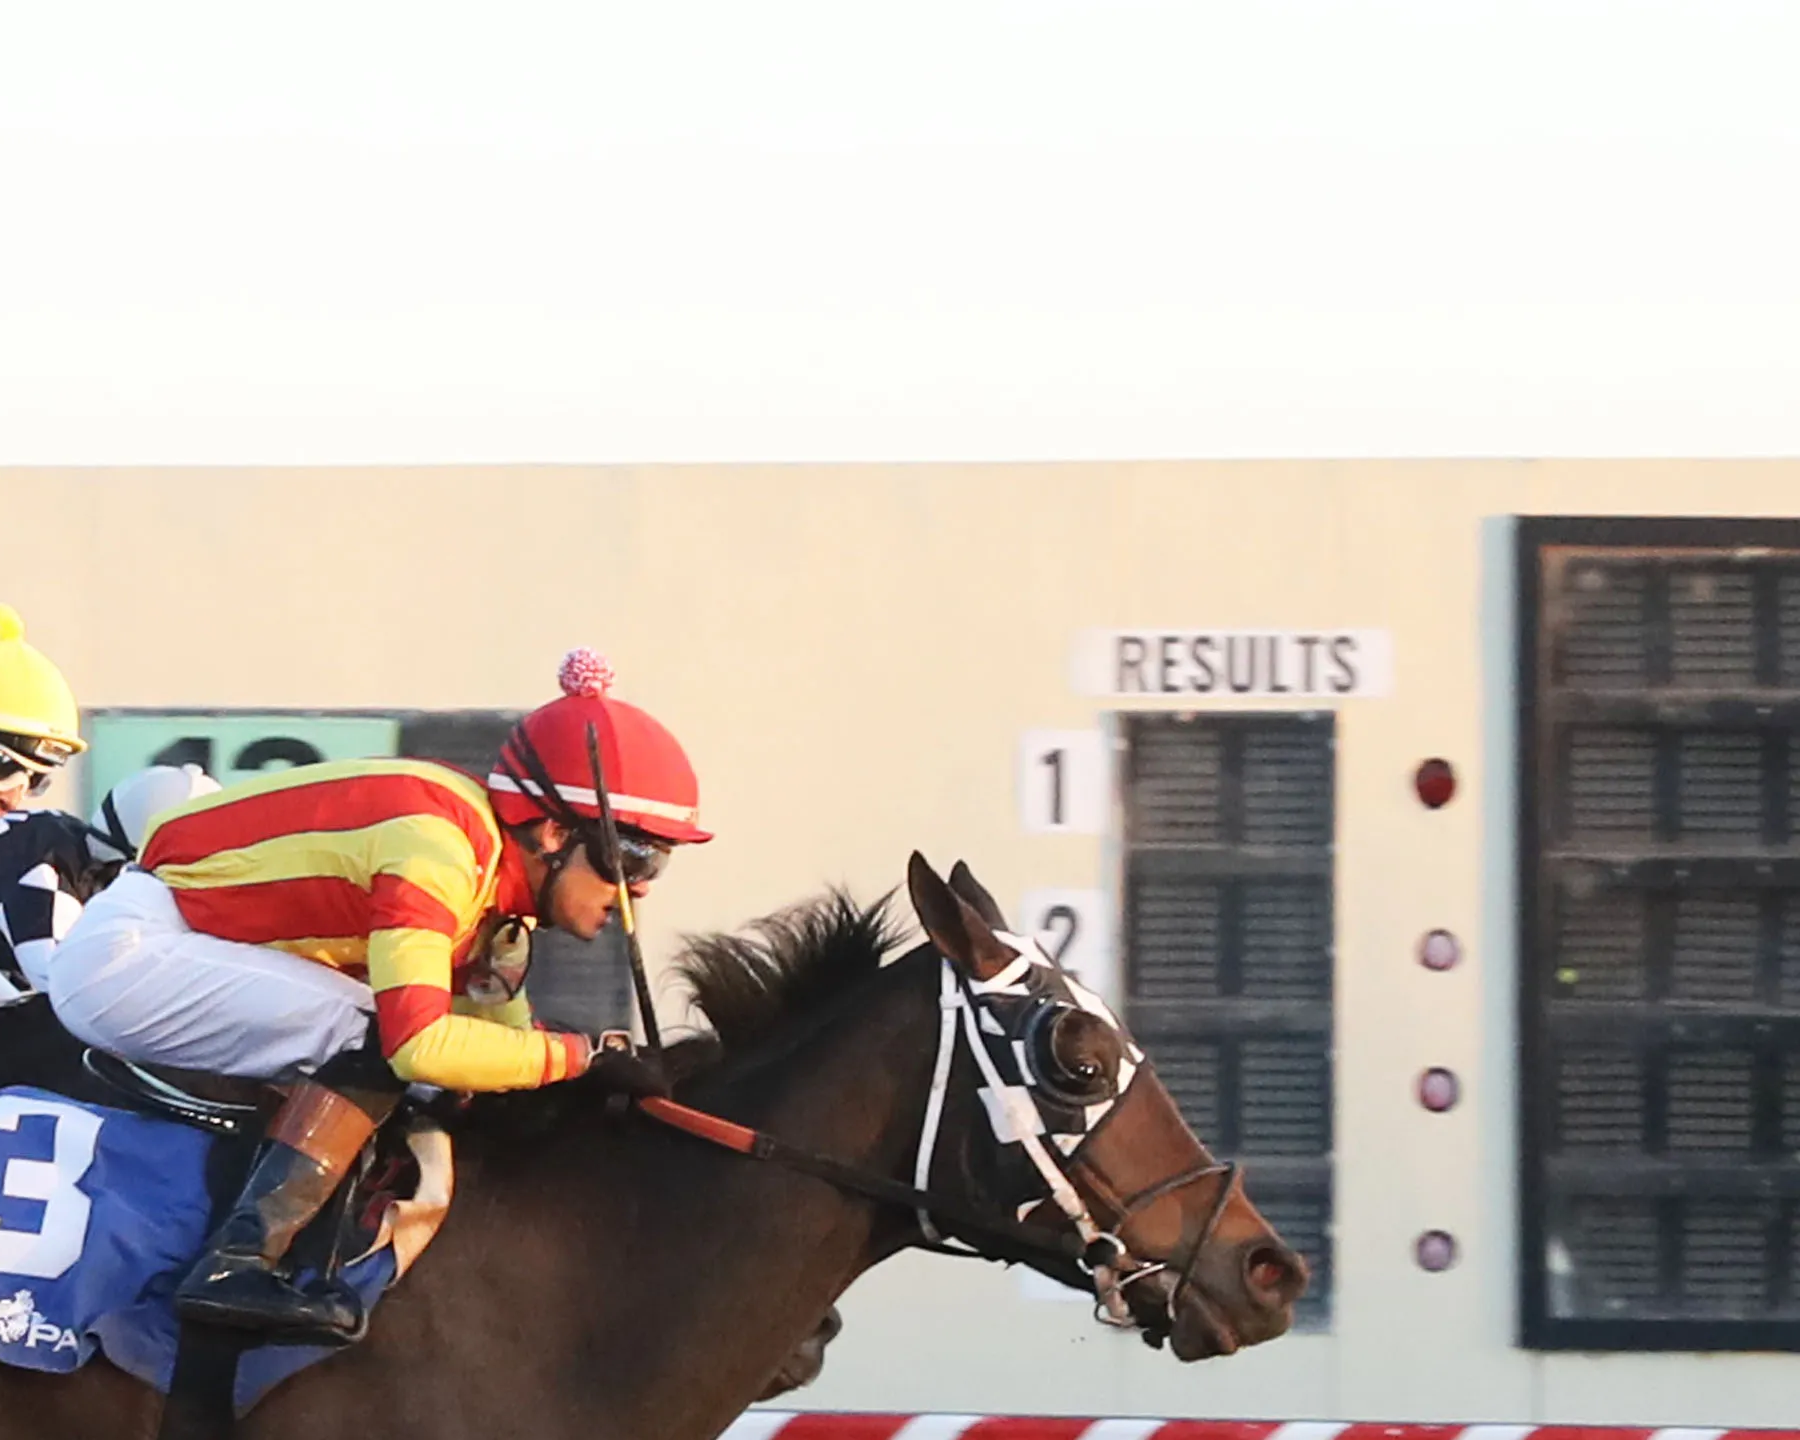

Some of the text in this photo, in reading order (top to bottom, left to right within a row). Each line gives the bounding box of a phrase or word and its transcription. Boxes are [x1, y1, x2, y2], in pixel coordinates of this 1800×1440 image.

[1116, 635, 1358, 694] RESULTS
[1039, 748, 1064, 825] 1
[1040, 904, 1081, 978] 2
